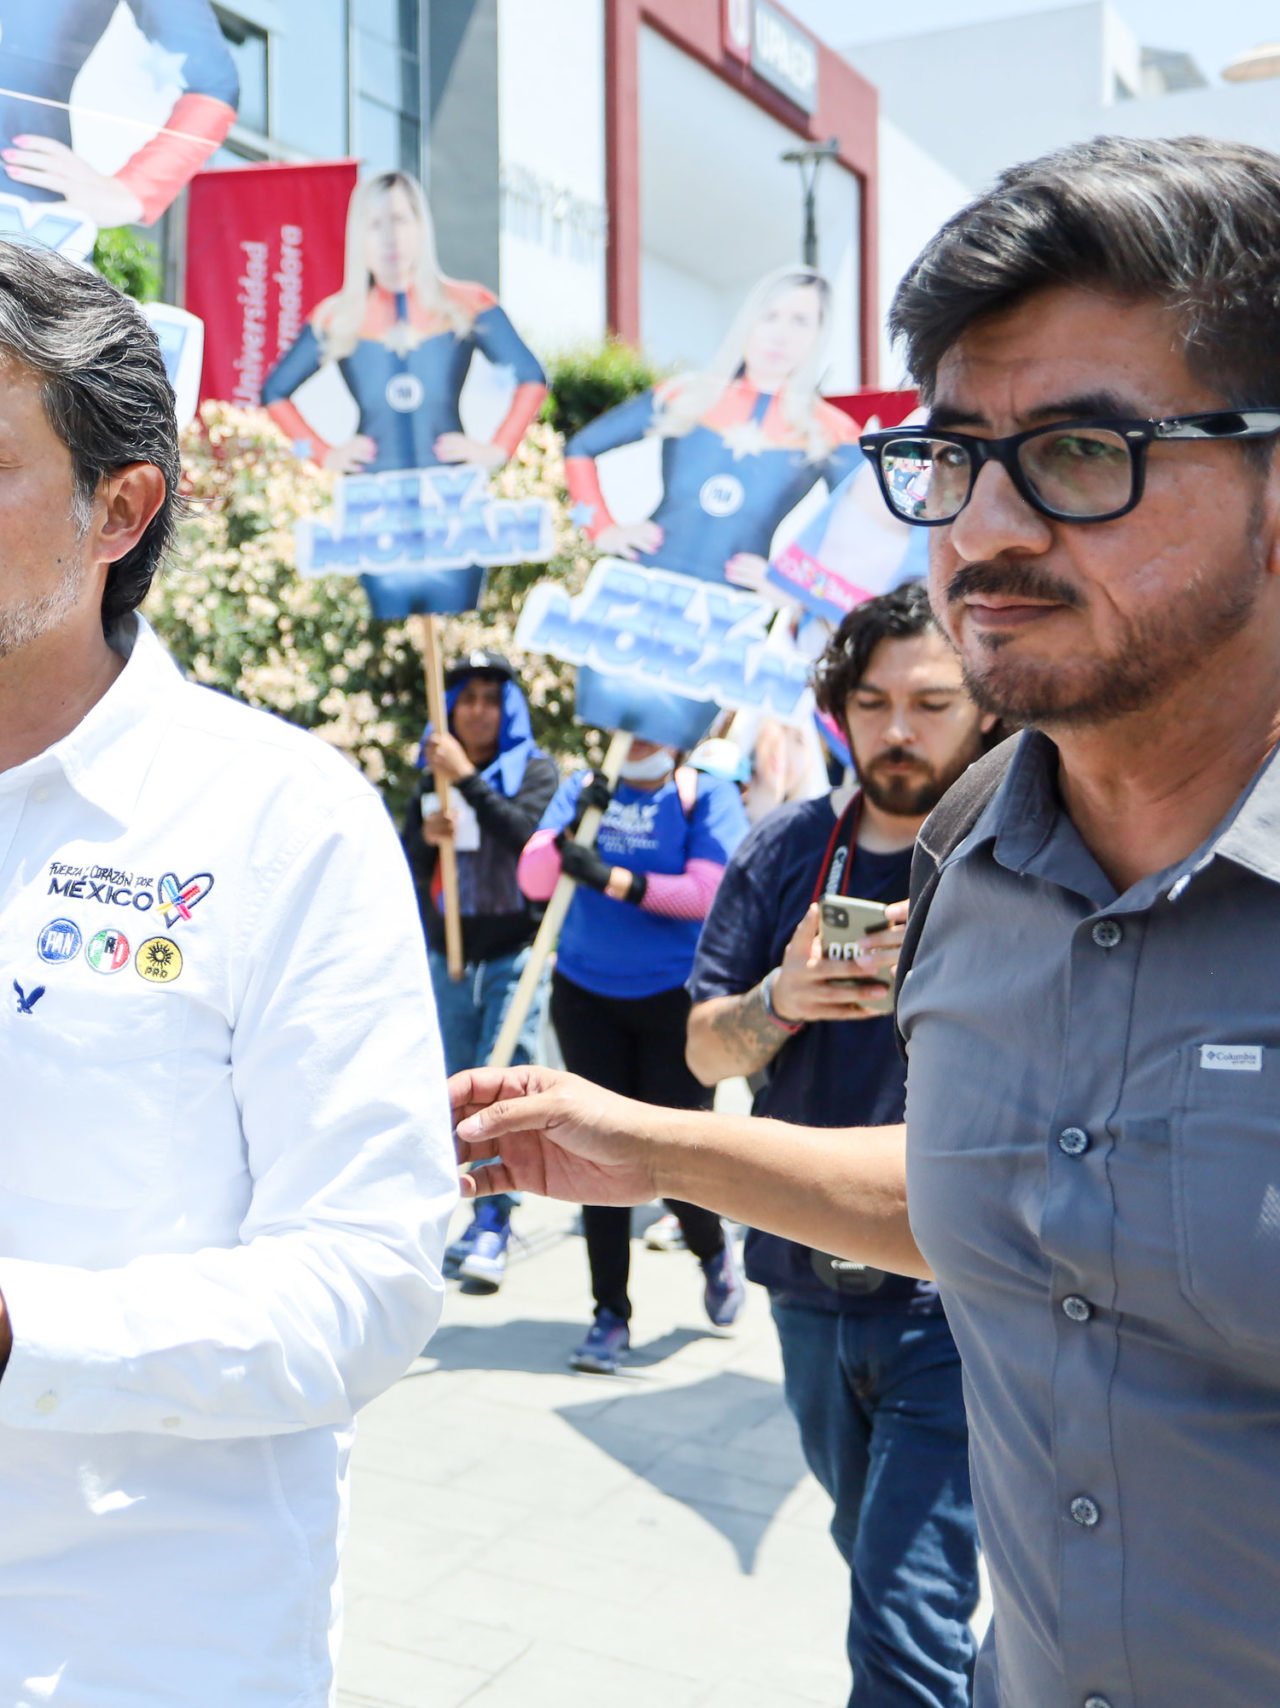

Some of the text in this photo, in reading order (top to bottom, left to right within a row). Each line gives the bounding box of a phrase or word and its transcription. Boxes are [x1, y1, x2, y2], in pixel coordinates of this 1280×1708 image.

[231, 241, 268, 409] Universidad
[49, 862, 82, 876] FUERZA
[90, 865, 133, 887] CORAZÓN
[135, 876, 154, 888] POR
[47, 876, 154, 912] MÉXICO
[45, 931, 75, 955] PAN
[90, 935, 125, 963] PRI
[144, 966, 169, 979] PRD
[1215, 1051, 1257, 1061] Columbia
